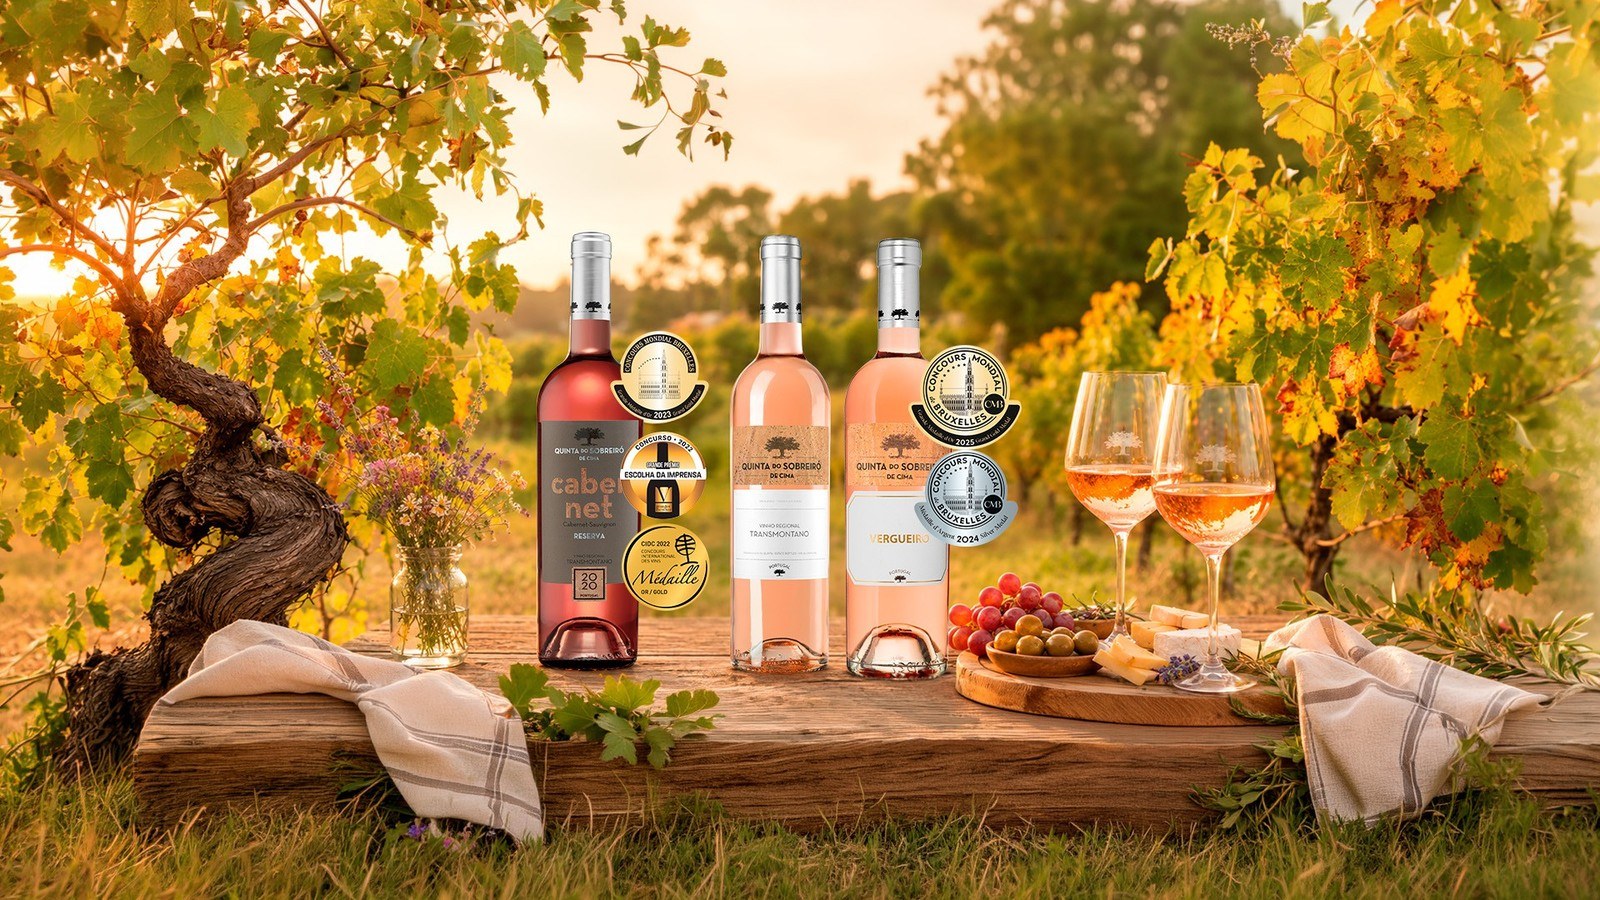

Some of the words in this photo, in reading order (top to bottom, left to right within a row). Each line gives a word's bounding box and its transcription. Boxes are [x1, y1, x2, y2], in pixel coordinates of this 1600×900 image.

[590, 446, 624, 454] SOBREIRÓ
[741, 462, 771, 470] QUINTA
[783, 460, 822, 470] SOBREIRÓ
[856, 462, 887, 471] QUINTA
[901, 462, 935, 471] SOBREI
[565, 495, 613, 519] net
[573, 532, 606, 540] RESERVA
[749, 530, 810, 538] TRANSMONTANO
[870, 534, 930, 544] VERGUEIRO
[581, 572, 597, 582] 20
[581, 581, 597, 590] 20
